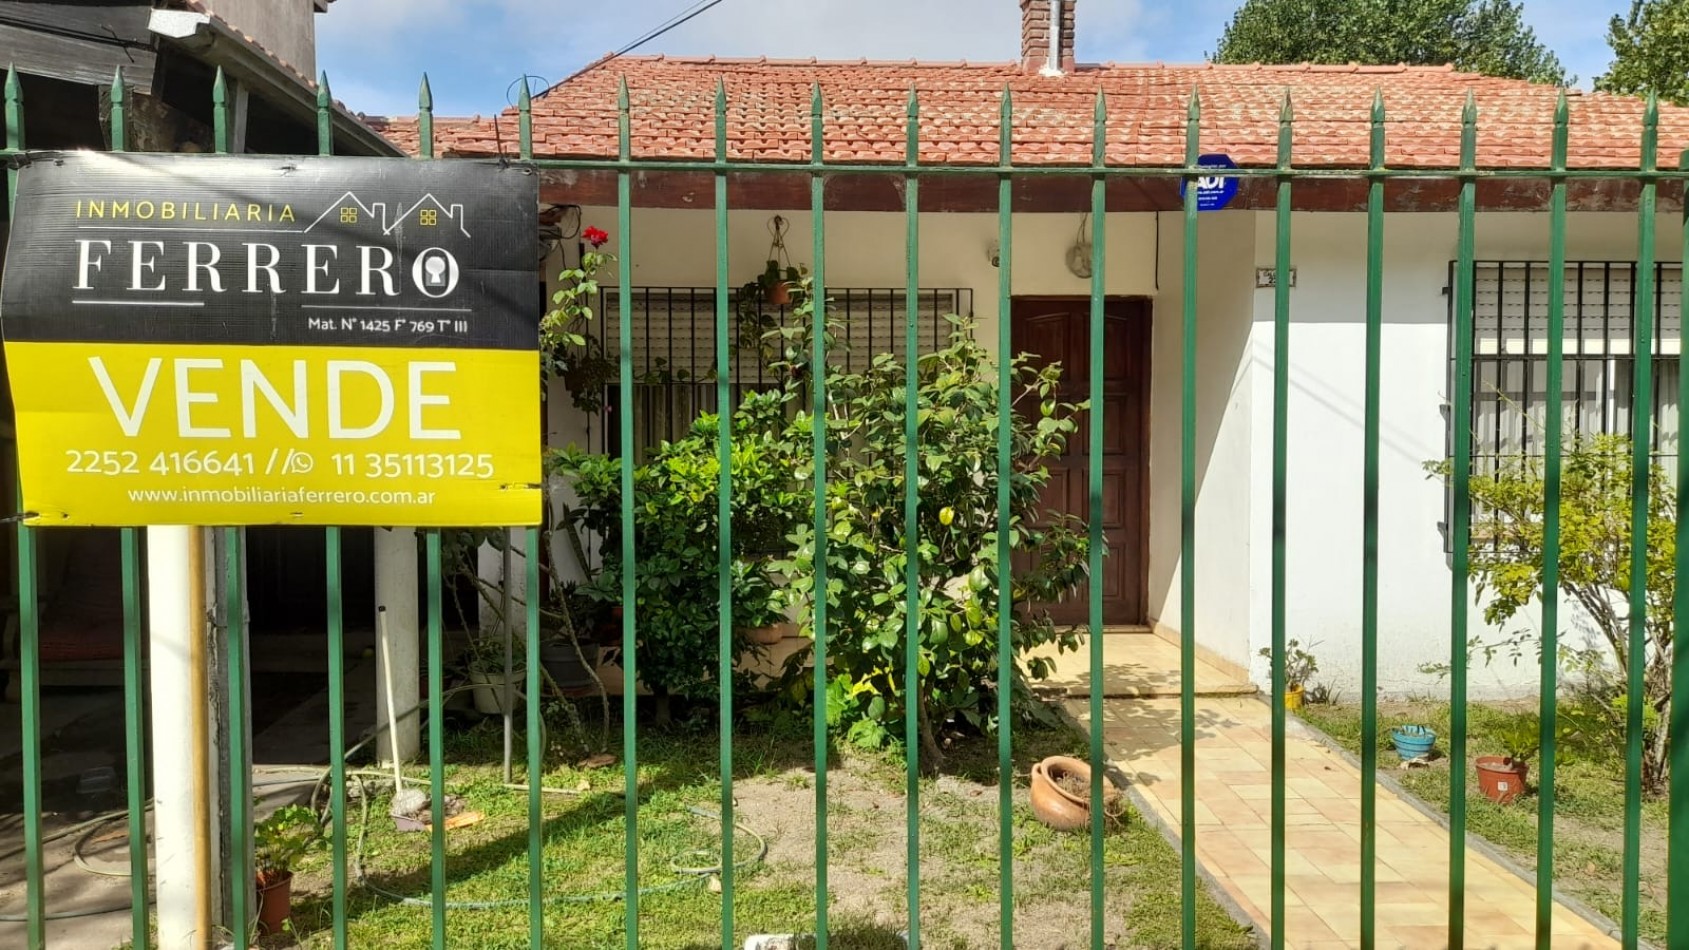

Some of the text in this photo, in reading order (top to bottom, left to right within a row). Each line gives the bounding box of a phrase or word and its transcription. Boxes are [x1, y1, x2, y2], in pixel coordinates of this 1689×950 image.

[75, 199, 298, 223] INMOBILIARIA
[72, 238, 460, 299] FERRERO
[307, 317, 338, 331] Mat.
[360, 319, 391, 333] 1425
[409, 320, 435, 333] 769
[454, 320, 469, 333] III
[88, 356, 463, 440] VENDE
[65, 449, 141, 476] 2252
[149, 450, 255, 477] 416641
[331, 453, 356, 476] 11
[365, 453, 495, 479] 35113125
[127, 485, 436, 505] www.inmobiliariaferrero.com.ar
